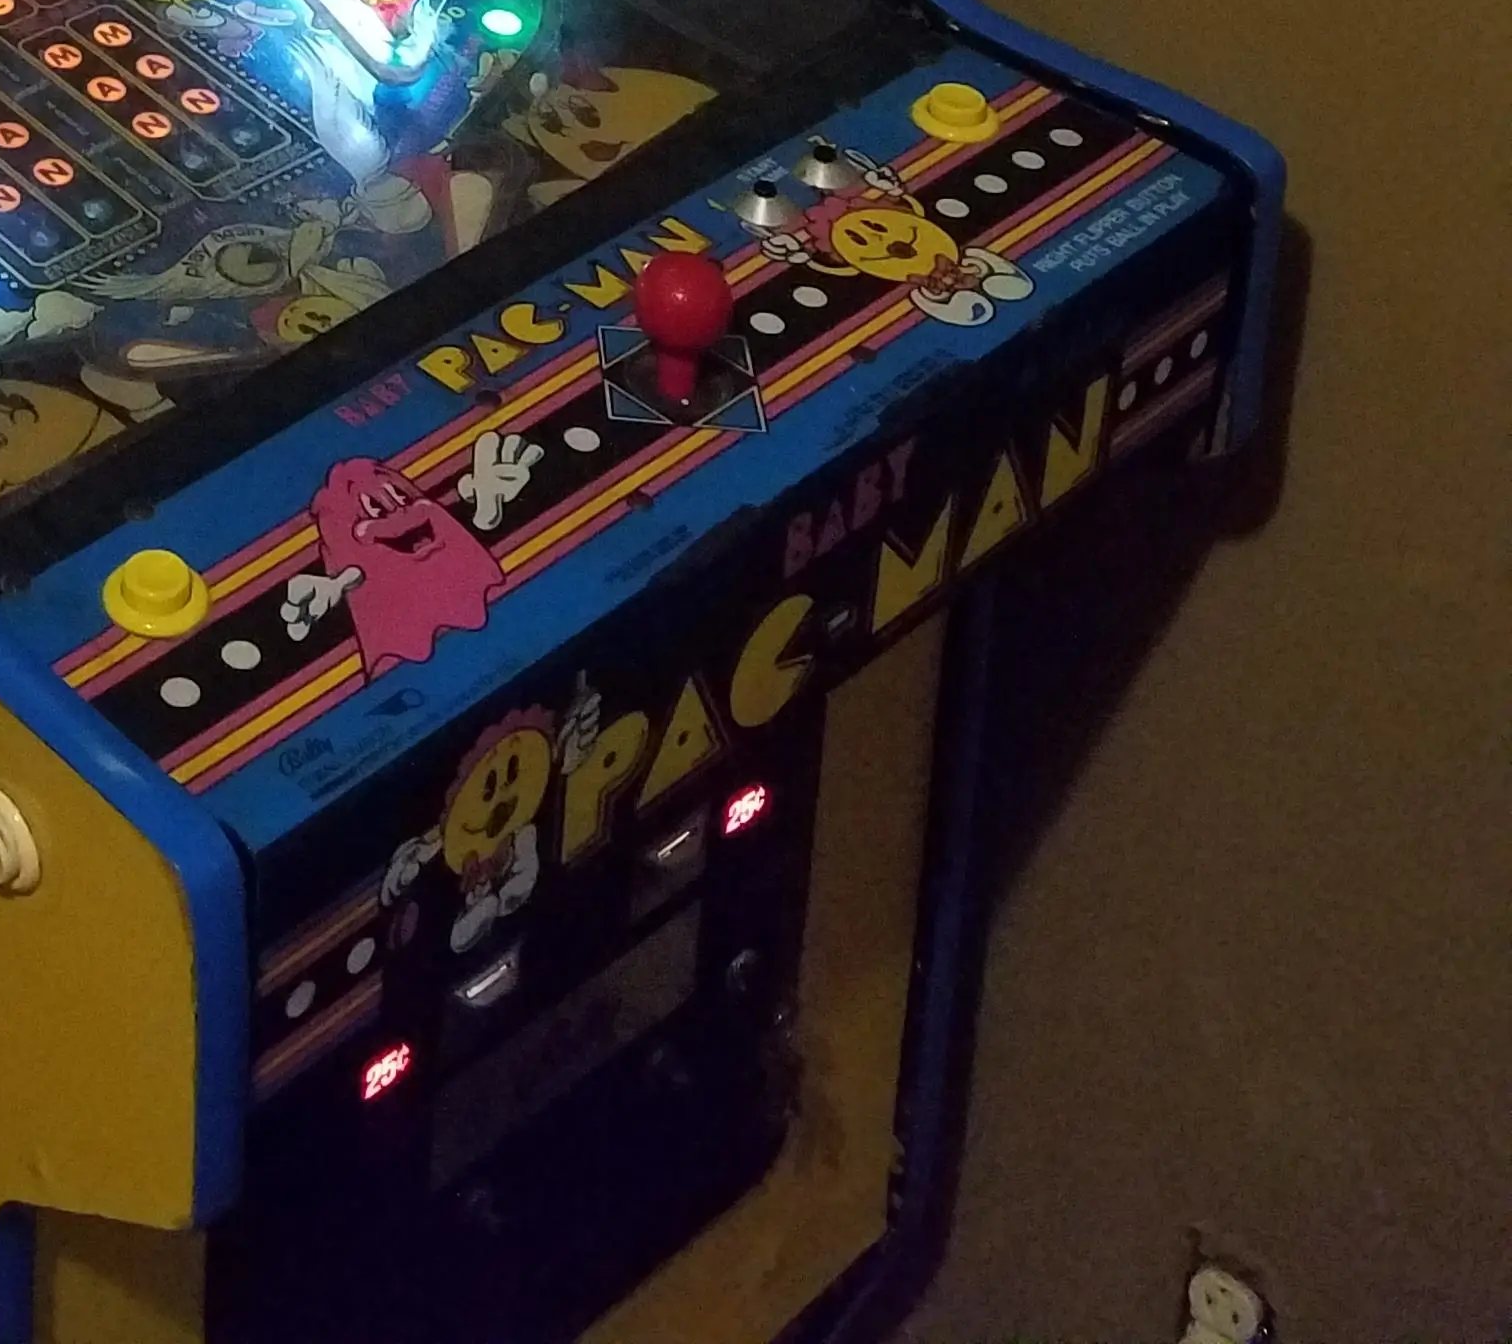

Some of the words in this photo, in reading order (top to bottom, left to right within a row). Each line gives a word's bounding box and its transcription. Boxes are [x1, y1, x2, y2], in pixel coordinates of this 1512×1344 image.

[1124, 173, 1184, 212] BUTTON
[784, 436, 918, 579] BABY
[561, 373, 1110, 866] PAC-MAN
[724, 784, 766, 836] 25¢
[361, 1041, 414, 1101] 25¢
